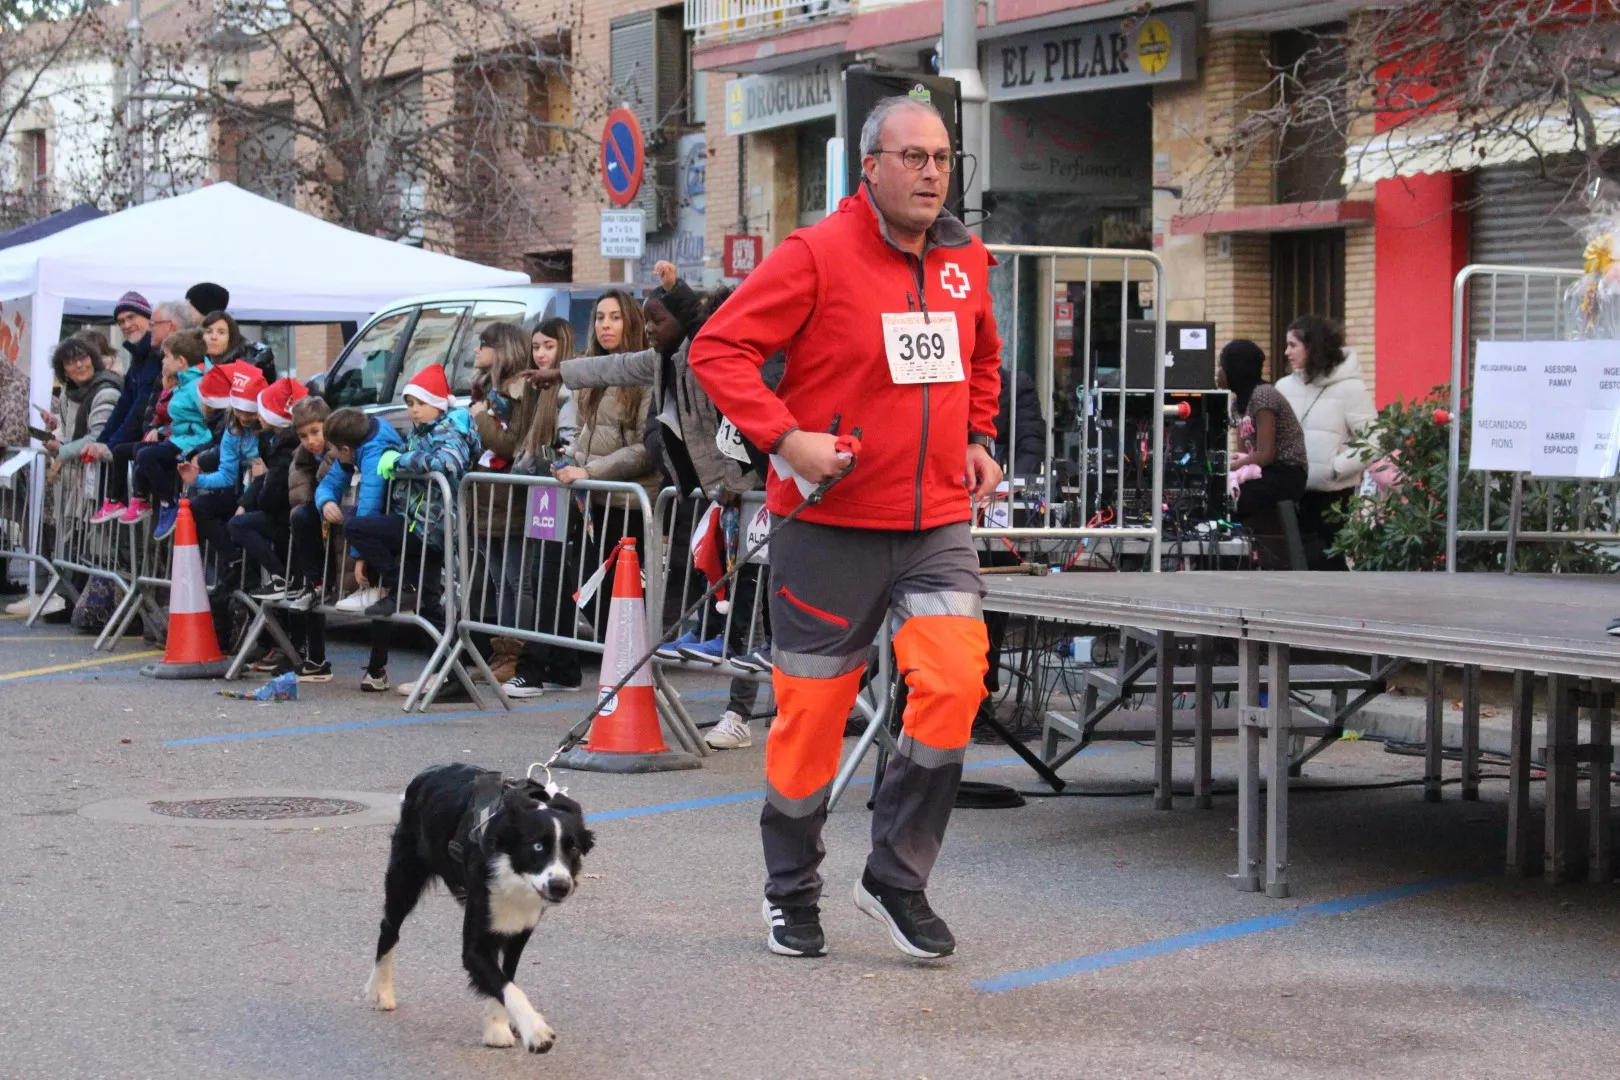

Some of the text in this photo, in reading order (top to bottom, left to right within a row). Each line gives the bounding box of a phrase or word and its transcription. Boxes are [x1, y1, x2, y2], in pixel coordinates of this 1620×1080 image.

[1001, 32, 1129, 88] EL PILAR
[747, 64, 832, 120] DROGUERÍA
[898, 332, 946, 361] 369
[1480, 364, 1512, 372] PELUQUERIA
[1544, 365, 1577, 373] ASESORIA
[1548, 379, 1572, 387] PAMAY
[1478, 420, 1527, 430] MECANIZADOS
[1546, 432, 1575, 441] KARMAR
[1491, 439, 1513, 449] PIONS
[1543, 446, 1578, 454] ESPACIOS
[532, 515, 555, 528] ALCO
[748, 532, 769, 544] ALC
